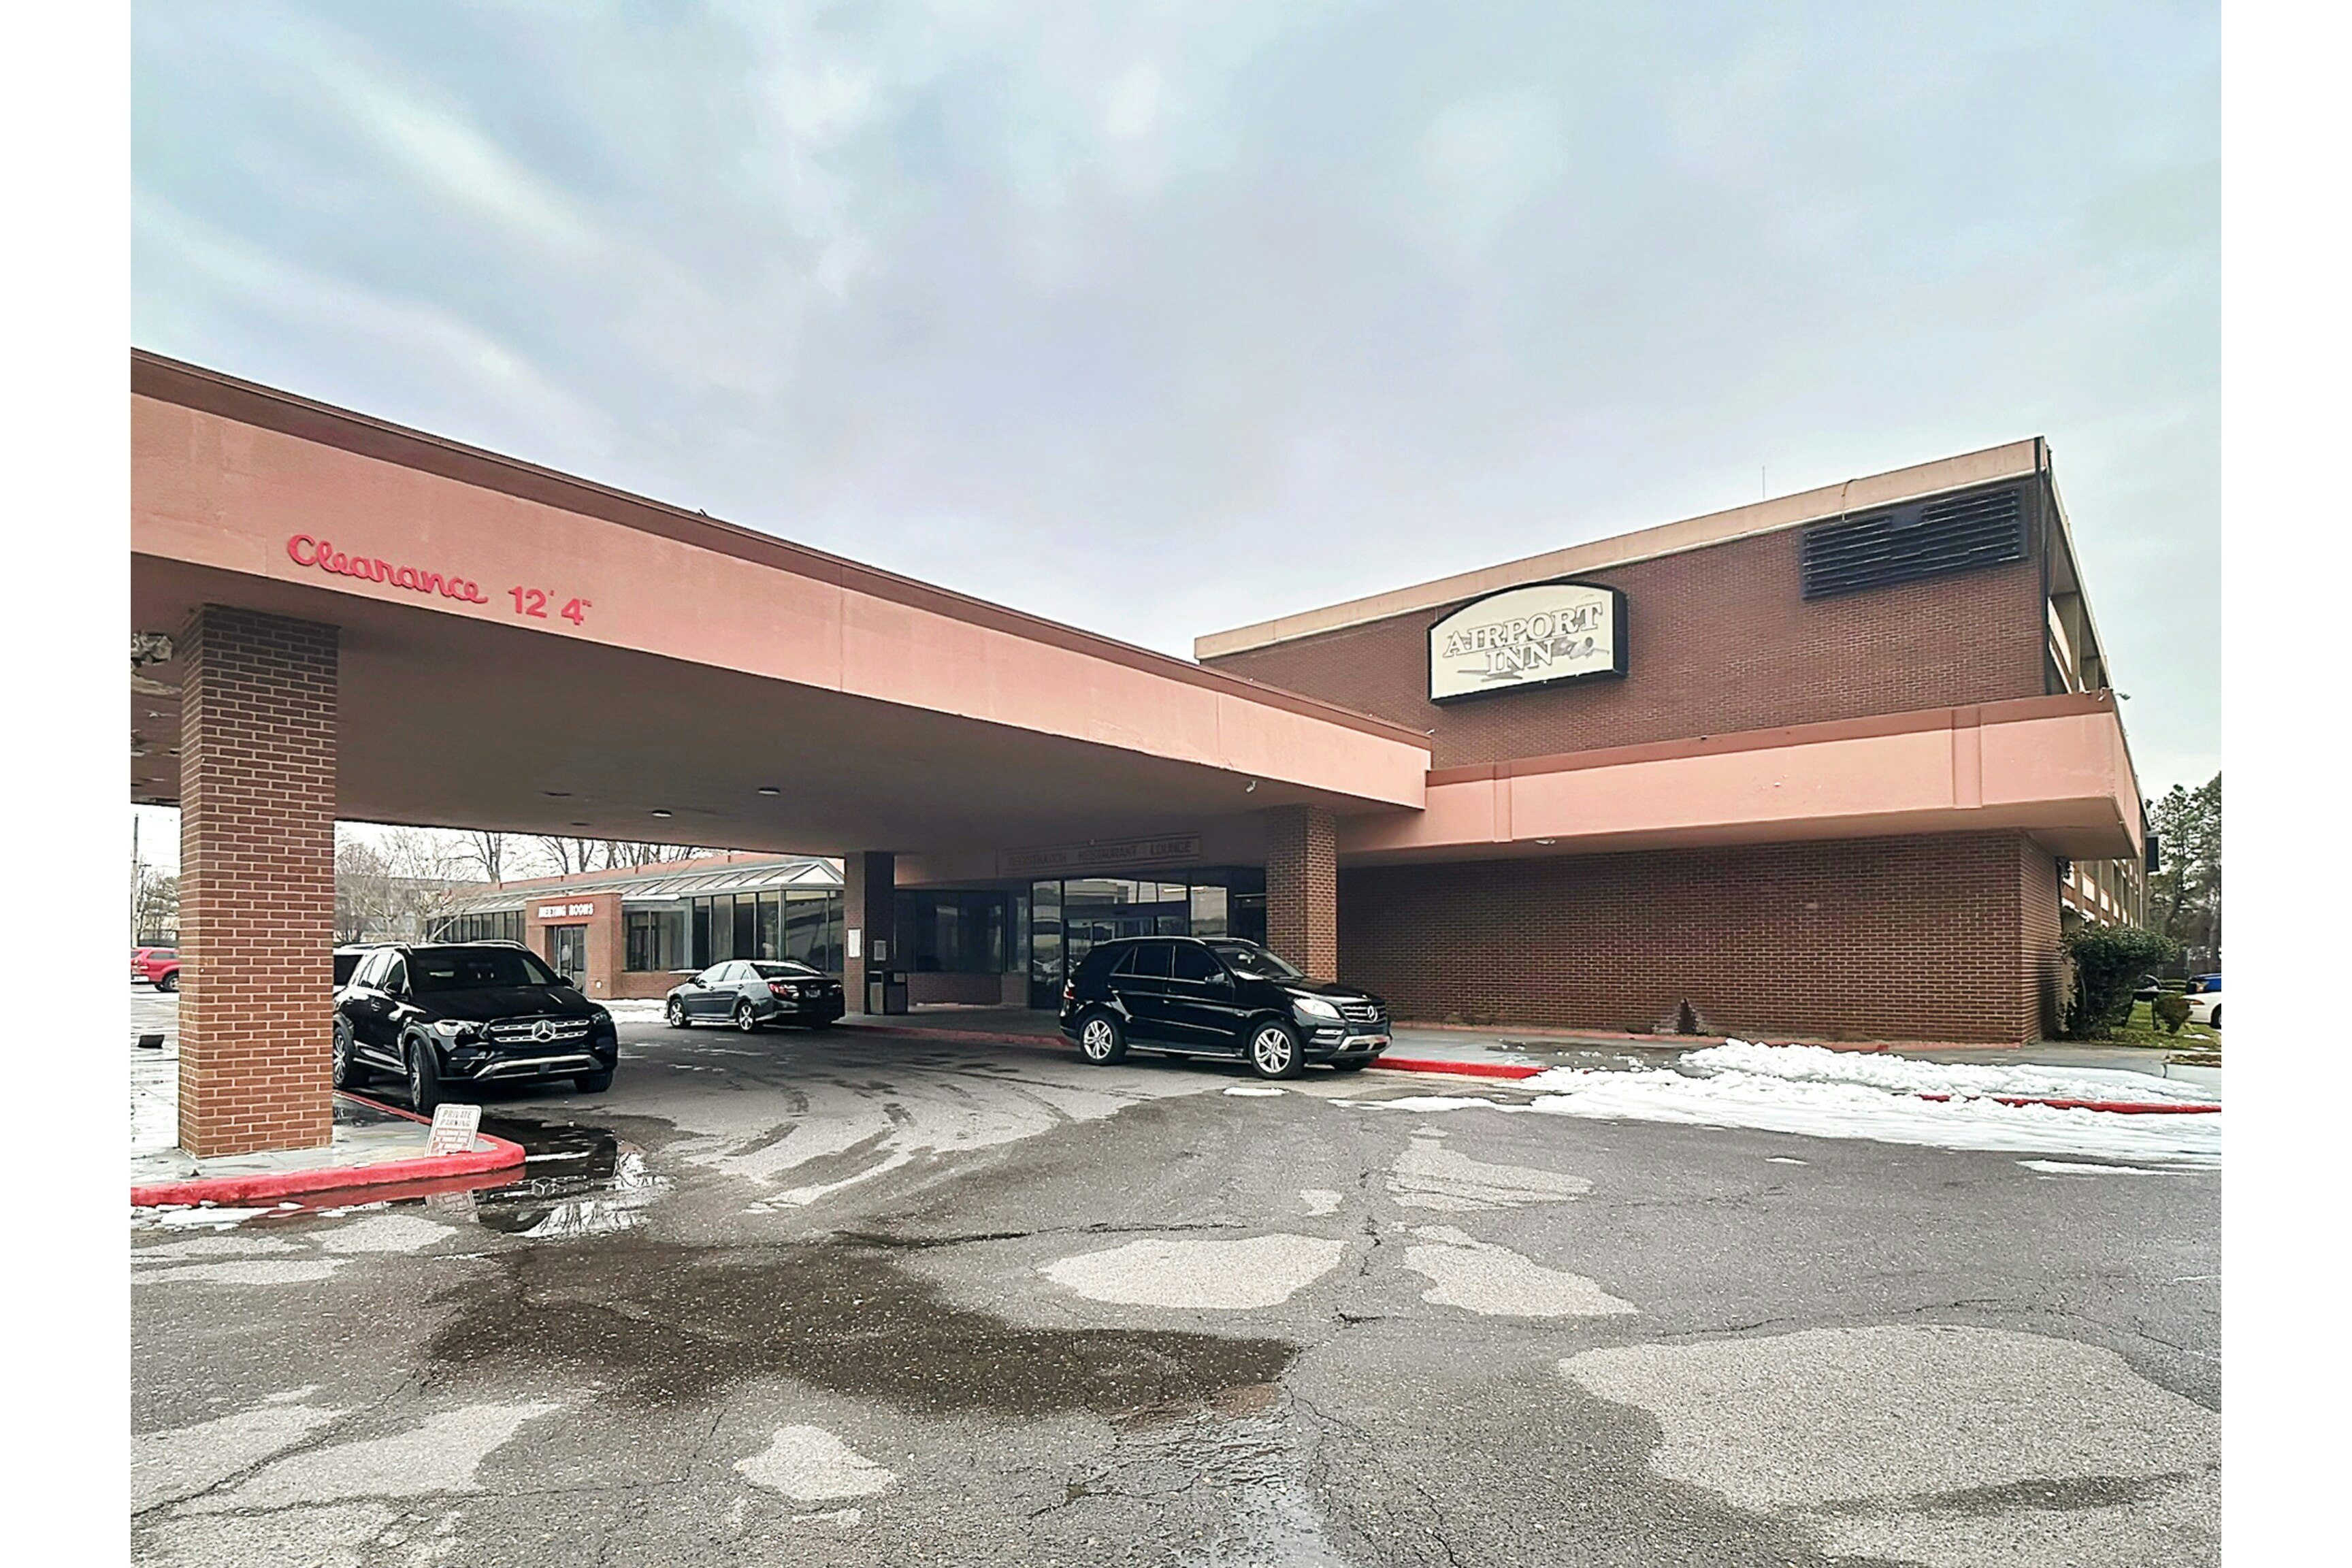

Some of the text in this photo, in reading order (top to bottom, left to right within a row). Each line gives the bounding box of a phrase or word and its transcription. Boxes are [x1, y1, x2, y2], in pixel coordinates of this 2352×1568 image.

[287, 534, 489, 604] Clearance
[1442, 602, 1603, 657] AIRPORT
[1485, 638, 1556, 675] INN
[1149, 840, 1192, 855] LOUNGE
[569, 902, 593, 916] ROOMS
[442, 1109, 472, 1118] PRIVATE
